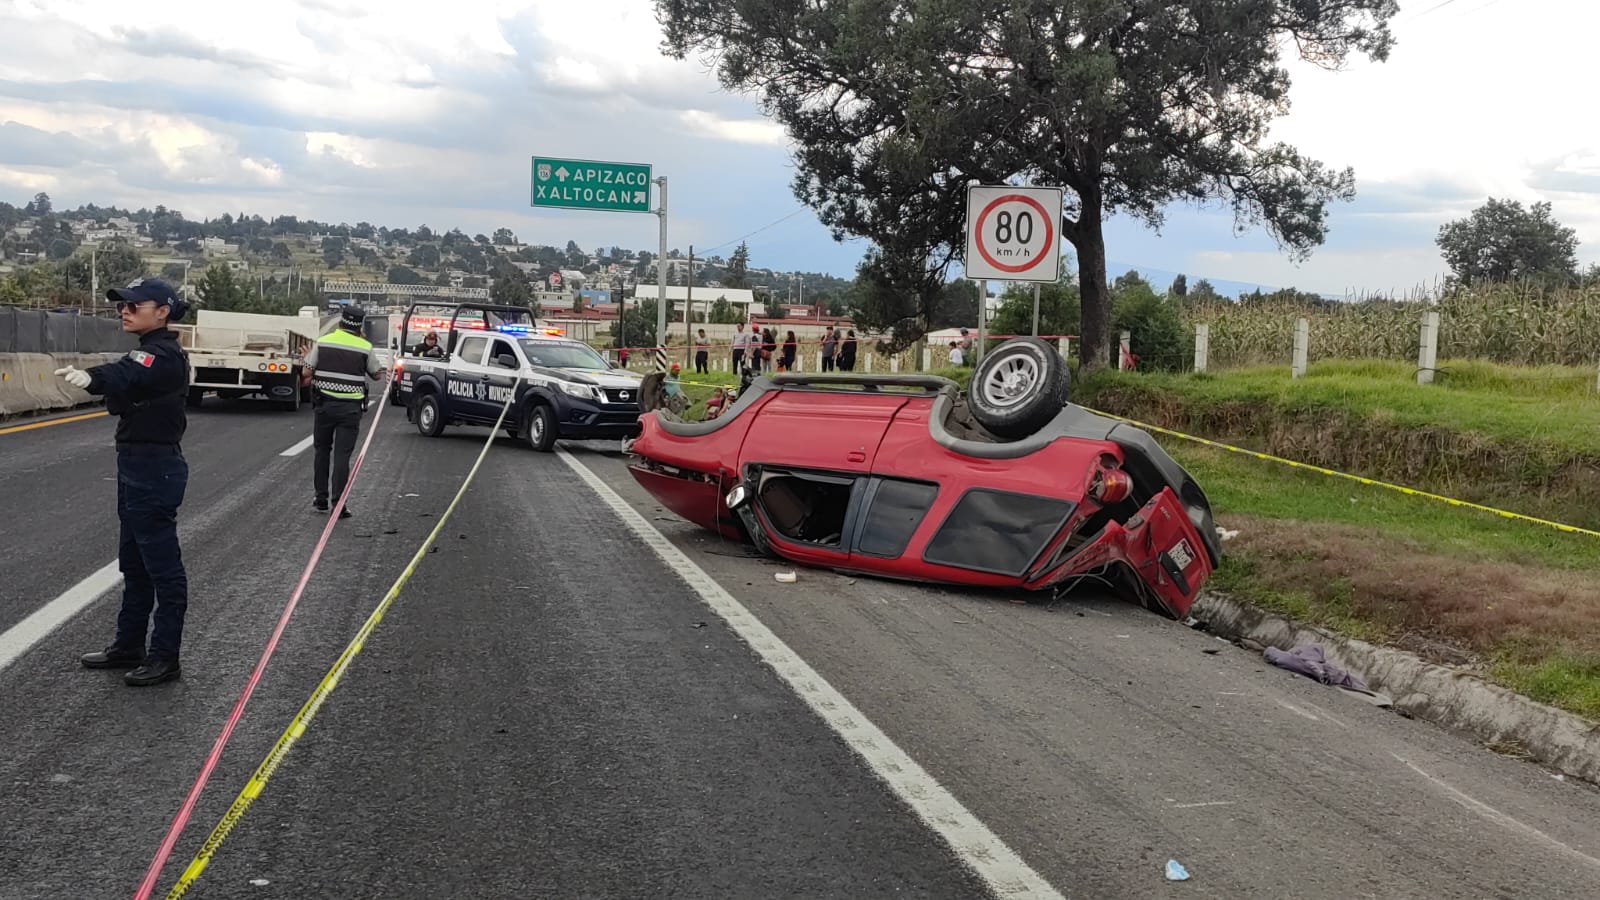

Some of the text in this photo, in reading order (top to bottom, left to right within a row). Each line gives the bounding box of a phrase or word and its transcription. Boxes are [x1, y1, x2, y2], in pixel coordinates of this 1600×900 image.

[573, 169, 647, 186] APIZACO
[536, 185, 631, 204] XALTOCAN
[995, 210, 1033, 244] 80
[447, 379, 474, 399] POLICIA
